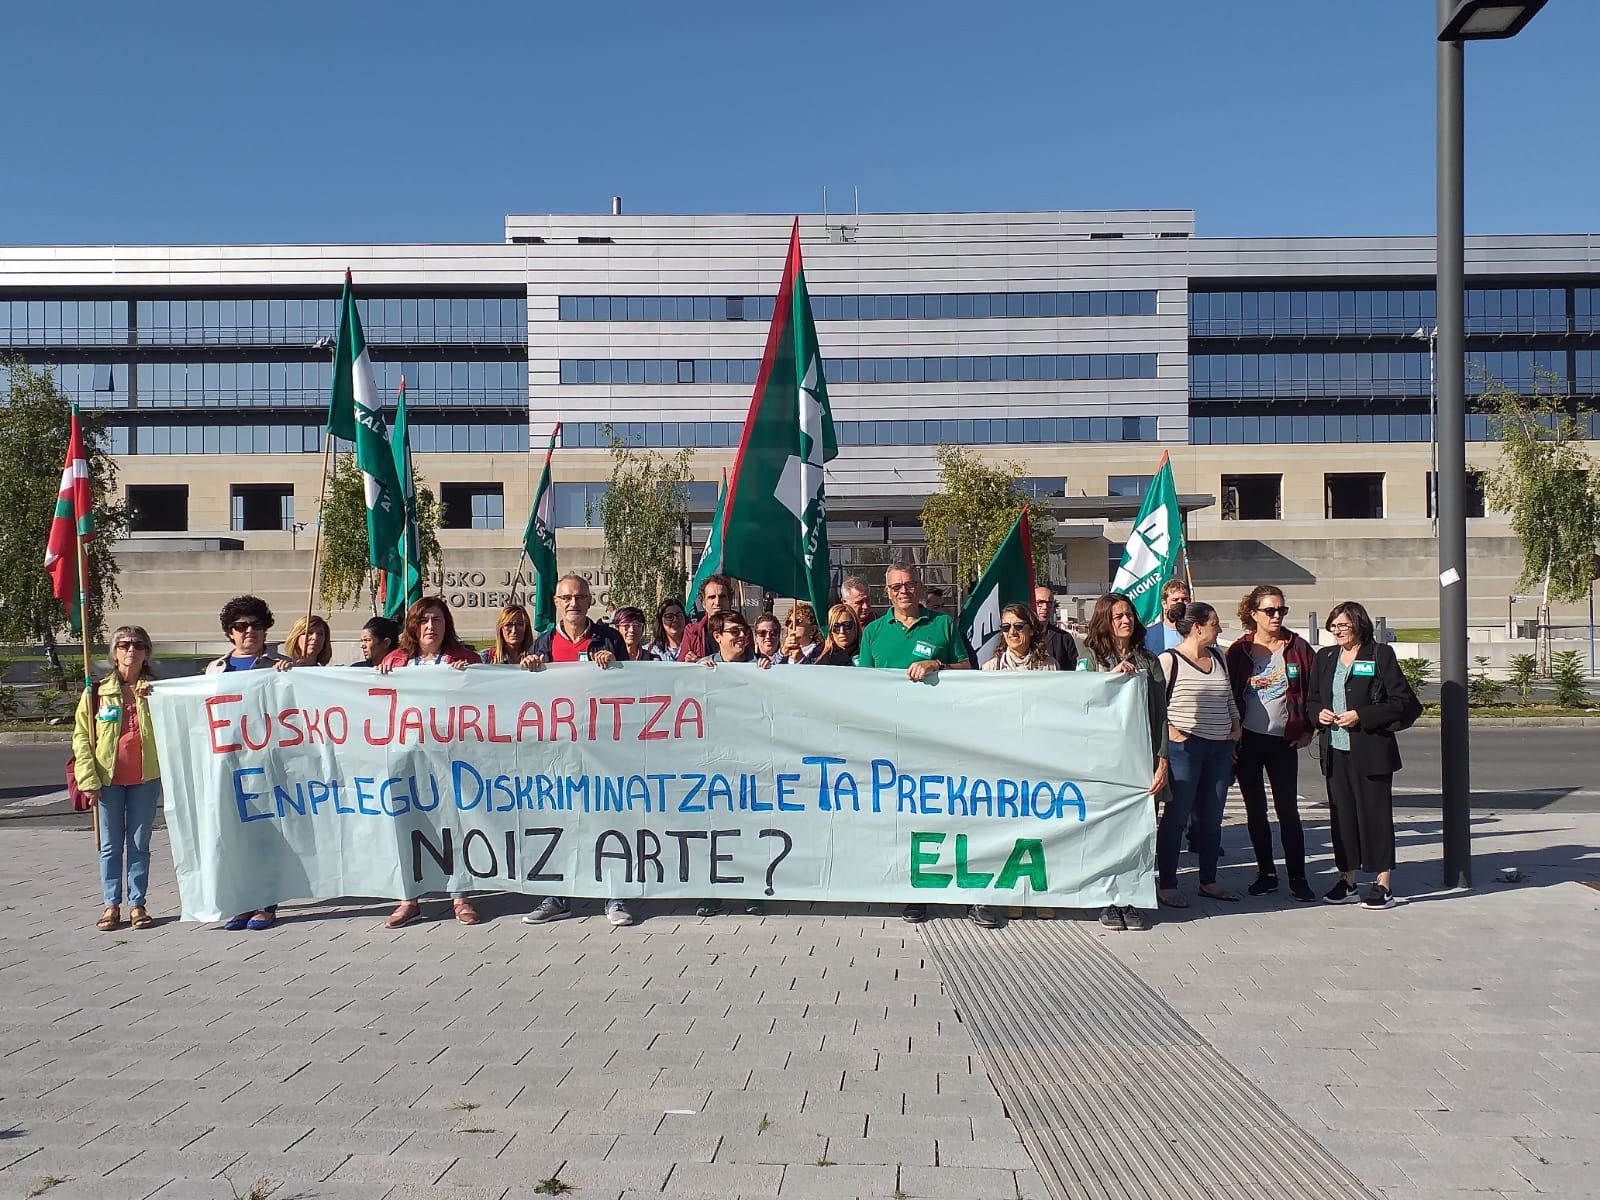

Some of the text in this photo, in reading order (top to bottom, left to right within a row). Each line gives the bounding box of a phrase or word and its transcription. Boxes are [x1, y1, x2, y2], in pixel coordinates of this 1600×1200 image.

[423, 571, 486, 587] USKO
[1354, 663, 1373, 673] ELA
[205, 688, 704, 754] EUSKO JAURLARITZA
[232, 756, 1086, 822] ENPLEGU DISKRIMINATZAILE TA PREKARIOA
[411, 827, 564, 882] NOIZ
[910, 831, 1048, 891] ELA
